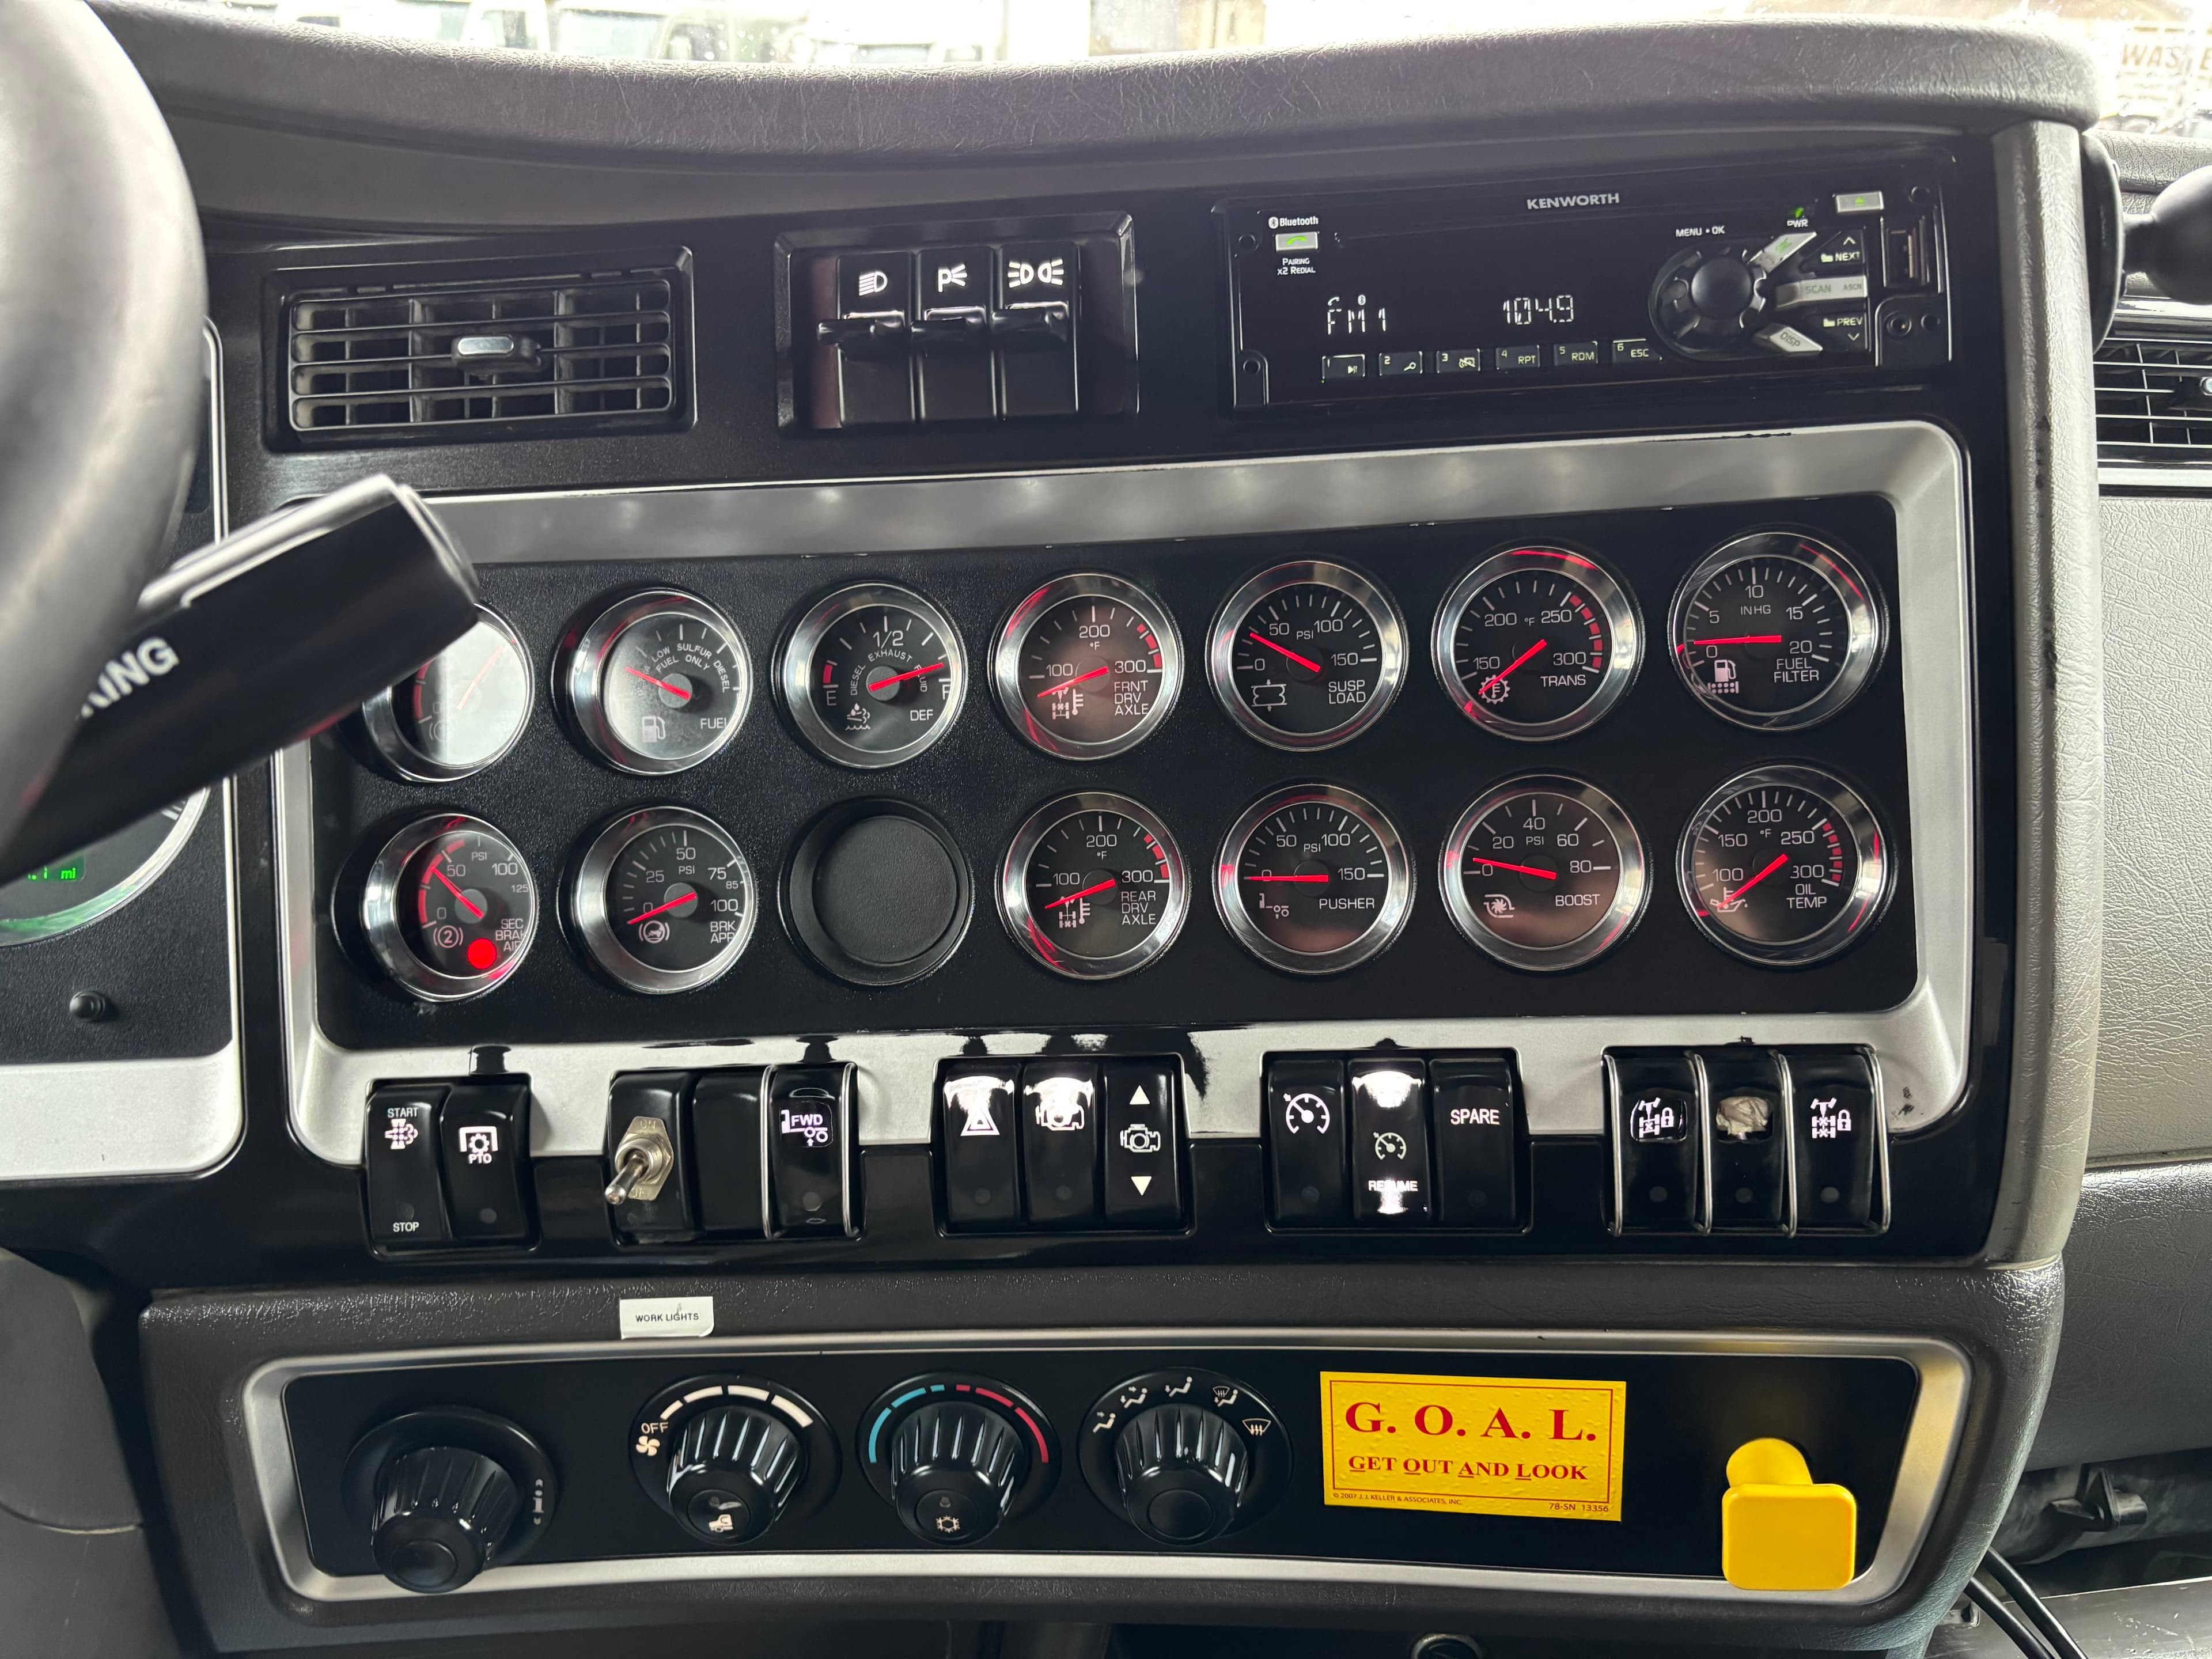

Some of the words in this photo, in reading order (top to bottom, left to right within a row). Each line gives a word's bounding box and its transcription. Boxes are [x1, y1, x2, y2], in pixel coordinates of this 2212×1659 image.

[2122, 44, 2212, 70] WASE
[1527, 193, 1620, 210] KENWORTH
[1279, 216, 1319, 227] Bluetooth
[1787, 219, 1809, 228] PWR
[1676, 228, 1702, 237] MENU
[1711, 225, 1725, 235] OK
[1282, 257, 1310, 266] PAIRING
[1835, 252, 1861, 262] NEXT
[1277, 267, 1289, 275] x2
[1290, 266, 1316, 275] REDIAL
[1805, 285, 1832, 294] SCAN
[1836, 317, 1863, 327] PREV
[1779, 331, 1801, 347] DISP
[1559, 346, 1566, 354] 5
[1617, 343, 1624, 351] 6
[1631, 348, 1649, 358] ESC
[1384, 356, 1391, 365] 2
[1501, 350, 1508, 358] 4
[1518, 355, 1536, 365] RPT
[1571, 351, 1594, 362] RDM
[1327, 358, 1331, 368] 1
[1745, 585, 1764, 599] 10
[1484, 613, 1517, 627] 200
[1541, 609, 1572, 623] 250
[1709, 611, 1719, 623] 5
[1786, 607, 1803, 620] 15
[1079, 624, 1111, 639] 200
[1269, 622, 1290, 636] 50
[1314, 619, 1343, 633] 100
[873, 630, 904, 649] 1/2
[1297, 630, 1314, 640] PSI
[1706, 645, 1718, 658] 0
[1789, 641, 1812, 654] 20
[656, 655, 679, 673] FUEL
[685, 654, 710, 671] ONLY
[1255, 658, 1266, 671] 0
[1330, 652, 1358, 666] 150
[1472, 656, 1500, 669] 150
[1553, 652, 1586, 666] 300
[1777, 658, 1812, 671] FUEL
[651, 646, 671, 662] LOW
[677, 643, 713, 660] SULFUR
[713, 660, 730, 693] DIESEL
[850, 665, 866, 696] DIESEL
[868, 649, 913, 662] EXHAUST
[914, 664, 928, 692] FUID
[1046, 663, 1074, 677] 100
[1115, 660, 1146, 673] 300
[1540, 674, 1586, 687] TRANS
[1774, 670, 1819, 683] FILTER
[942, 684, 950, 700] F
[1114, 680, 1149, 692] FRNT
[1328, 679, 1365, 692] SUSP
[827, 691, 837, 706] E
[1115, 692, 1142, 704] DRV
[1328, 691, 1366, 704] LOAD
[910, 709, 934, 721] DEF
[1115, 703, 1149, 716] AXLE
[700, 717, 727, 730] FUEL
[1747, 809, 1782, 823] 200
[1523, 817, 1546, 831] 40
[1086, 834, 1118, 848] 200
[1277, 835, 1297, 847] 50
[1321, 834, 1350, 846] 100
[1493, 836, 1514, 849] 20
[1526, 836, 1544, 846] PSI
[1557, 834, 1580, 847] 60
[1718, 834, 1748, 847] 150
[1781, 830, 1815, 844] 250
[676, 847, 696, 861] 50
[1304, 843, 1321, 853] PSI
[471, 852, 487, 861] PSI
[446, 864, 466, 877] 50
[491, 862, 518, 876] 100
[679, 866, 695, 875] PSI
[1482, 864, 1494, 877] 0
[1570, 860, 1592, 873] 80
[1790, 865, 1824, 878] 300
[60, 867, 77, 880] mi
[646, 870, 665, 883] 25
[708, 867, 727, 880] 75
[1053, 872, 1080, 885] 100
[1122, 870, 1153, 883] 300
[1262, 869, 1272, 881] 0
[1338, 868, 1365, 881] 150
[1712, 868, 1744, 882] 100
[511, 884, 529, 893] 125
[726, 880, 738, 889] 85
[1795, 883, 1816, 896] OIL
[1121, 891, 1156, 903] REAR
[1319, 897, 1375, 910] PUSHER
[1555, 893, 1601, 907] BOOST
[1786, 896, 1827, 909] TEMP
[643, 902, 653, 914] 0
[710, 899, 738, 912] 100
[1122, 902, 1149, 914] DRV
[437, 907, 447, 919] 0
[501, 918, 524, 930] SEC
[710, 920, 736, 932] BRK
[1122, 914, 1156, 926] AXLE
[710, 931, 736, 944] APP
[387, 1107, 419, 1118] START
[1450, 1108, 1501, 1125] SPARE
[791, 1113, 824, 1127] FWD
[468, 1153, 493, 1164] PTO
[392, 1221, 419, 1232] STOP
[635, 1314, 663, 1323] WORK
[666, 1313, 699, 1321] LIGHTS
[641, 1422, 669, 1434] OFF
[1345, 1402, 1397, 1433] G.
[1414, 1404, 1467, 1437] O.
[1480, 1407, 1531, 1440] A.
[1548, 1409, 1596, 1441] L.
[1349, 1456, 1397, 1472] GET
[1403, 1458, 1453, 1475] OUT
[1458, 1461, 1509, 1478] AND
[1515, 1464, 1588, 1481] LOOK
[1404, 1496, 1447, 1505] ASSOCIATES,
[1549, 1502, 1576, 1510] 78-SN
[1582, 1504, 1609, 1512] 13356
